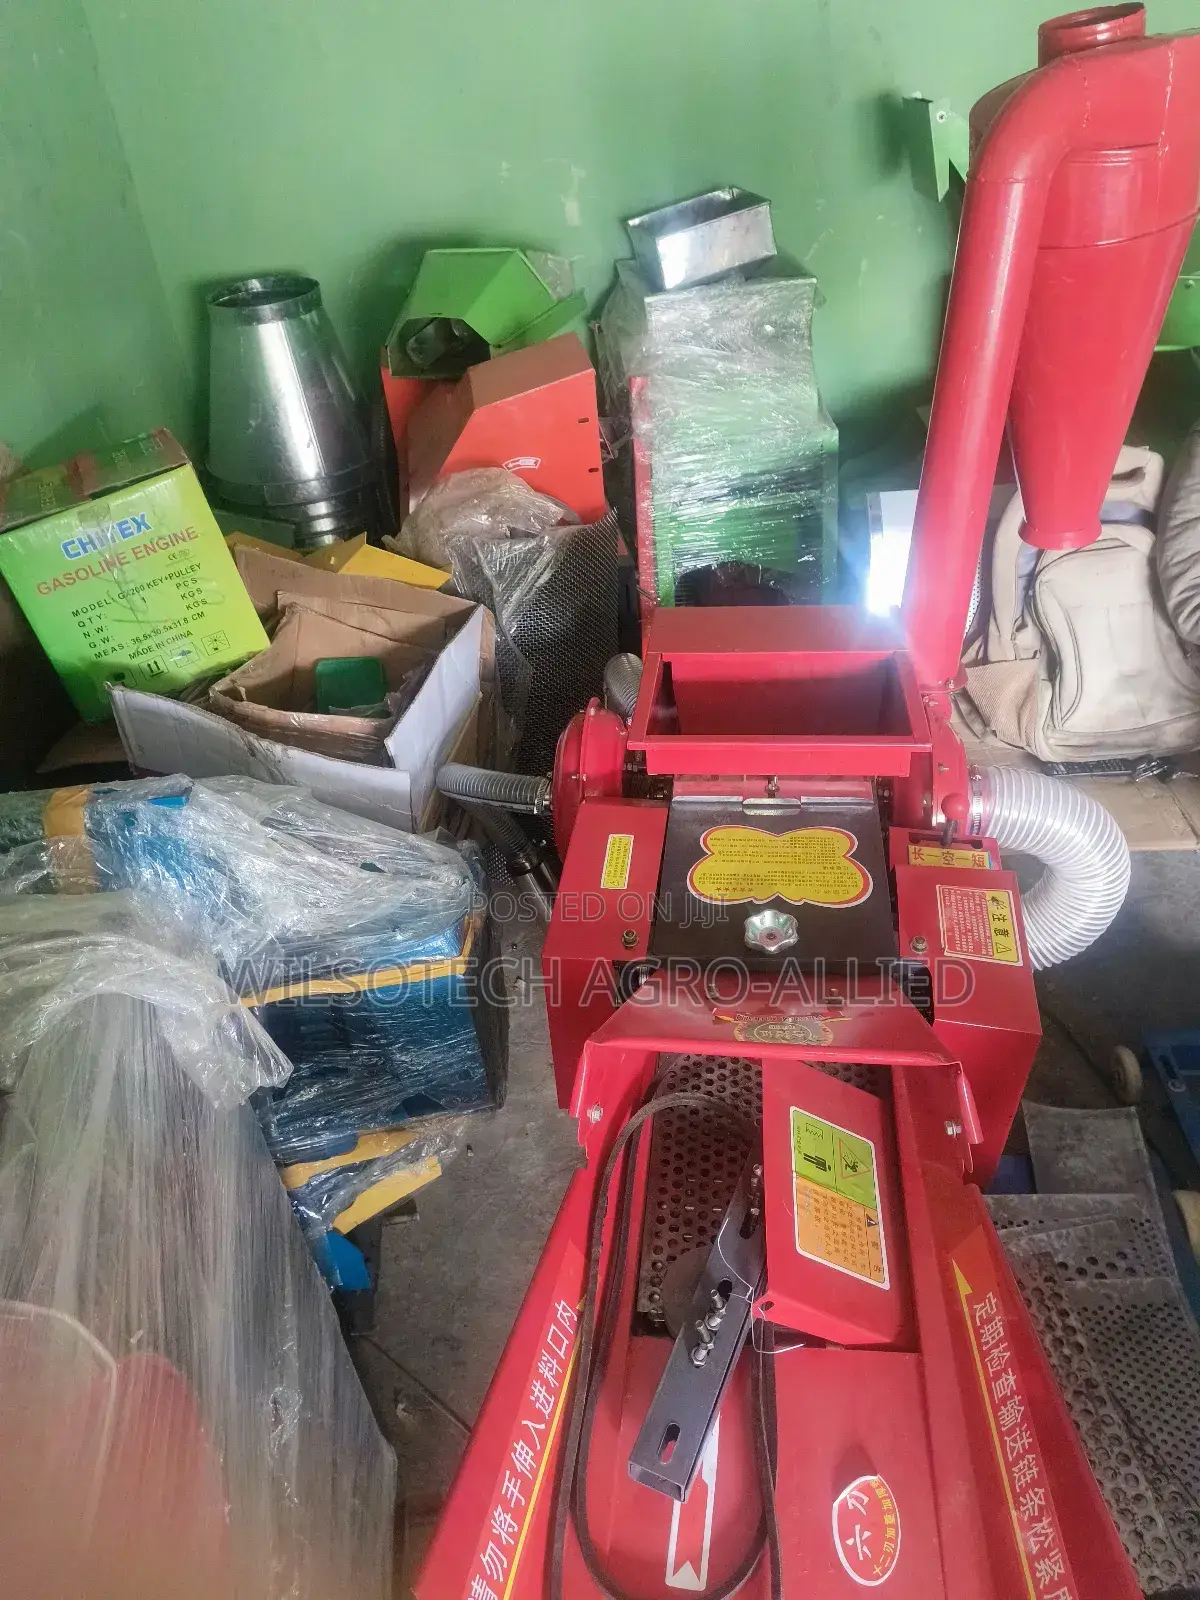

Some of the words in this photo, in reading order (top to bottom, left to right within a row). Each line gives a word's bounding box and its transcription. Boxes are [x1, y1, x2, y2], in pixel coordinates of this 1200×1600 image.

[36, 552, 130, 596] GASOLINE
[131, 525, 199, 561] ENGINE
[71, 597, 115, 618] MODEL:
[146, 562, 201, 589] KEY+PULLEY
[77, 612, 108, 628] QTY:
[175, 577, 198, 590] PCS
[180, 587, 203, 601] KGS
[185, 598, 208, 611] KGS
[93, 643, 129, 660] MEAS:
[191, 611, 206, 622] CM
[128, 646, 155, 661] MADE
[155, 641, 165, 650] IN
[166, 629, 193, 646] CHINA
[991, 913, 1010, 938] 注意
